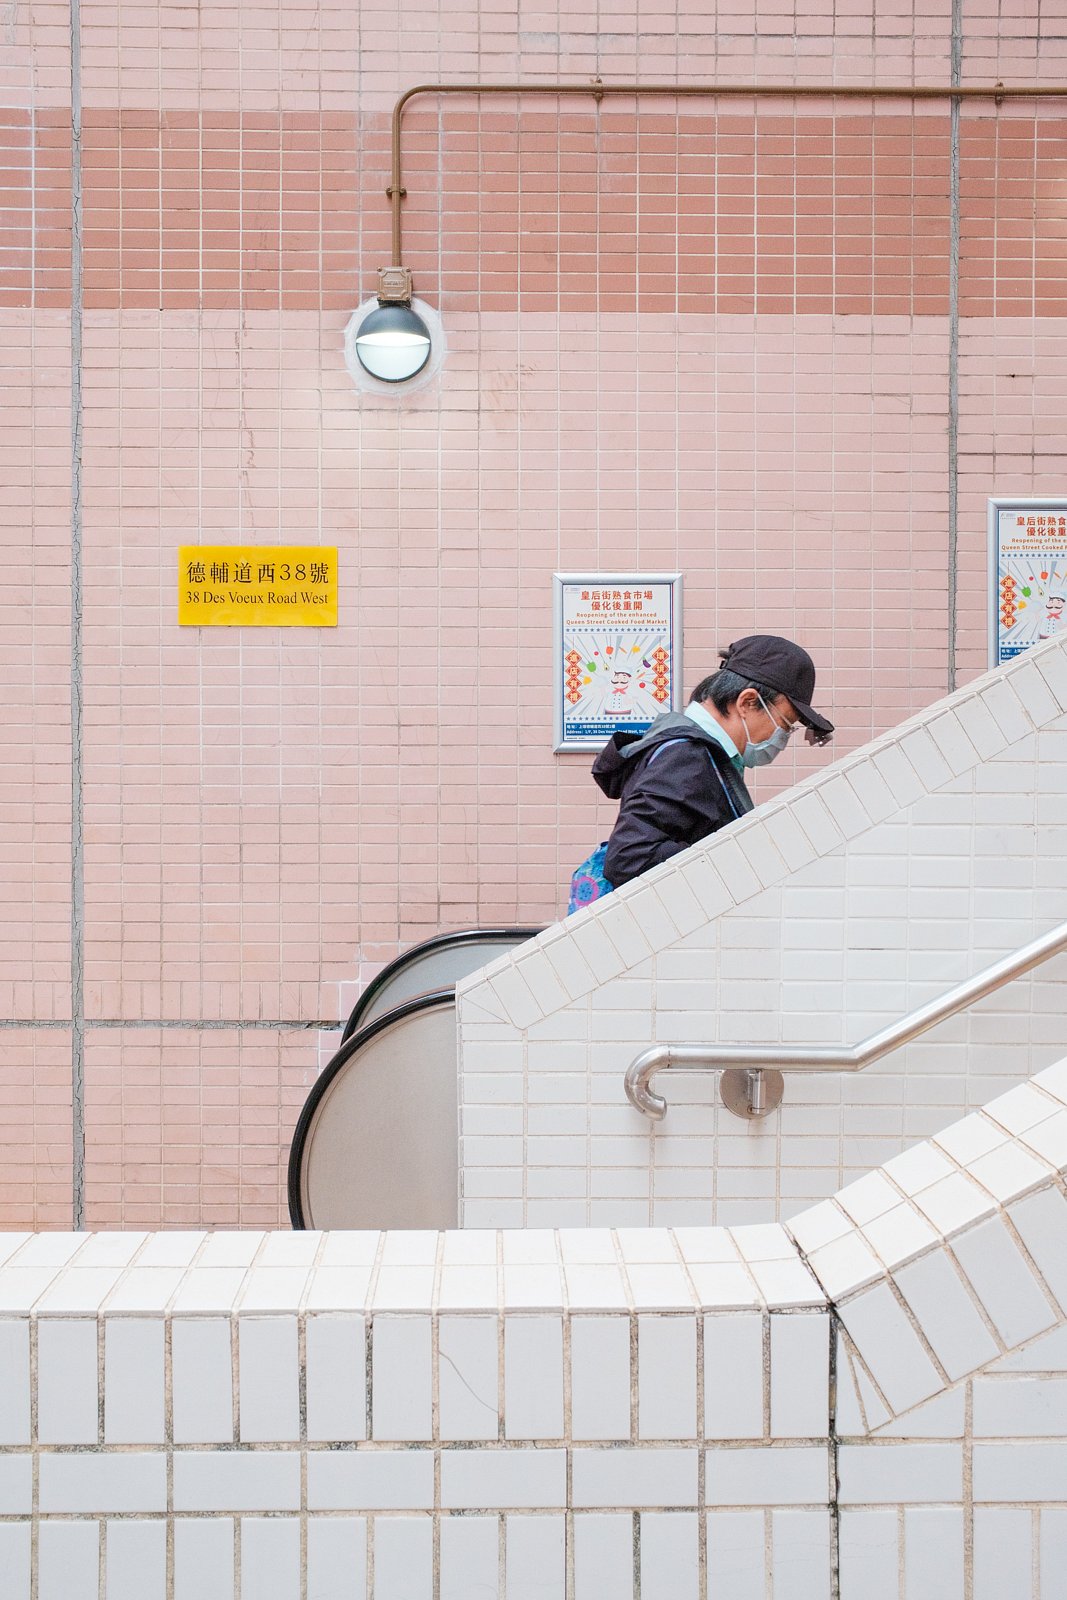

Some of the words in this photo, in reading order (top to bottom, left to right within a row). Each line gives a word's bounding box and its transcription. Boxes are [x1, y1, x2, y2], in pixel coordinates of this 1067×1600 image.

[186, 561, 329, 584] 德輔道西38號
[185, 591, 200, 604] 38
[203, 591, 225, 604] Des
[228, 591, 264, 604] Voeux
[267, 591, 297, 604] Road
[300, 591, 328, 604] West
[580, 590, 653, 600] 皇后街熟食市場
[591, 601, 643, 611] 優化後重開
